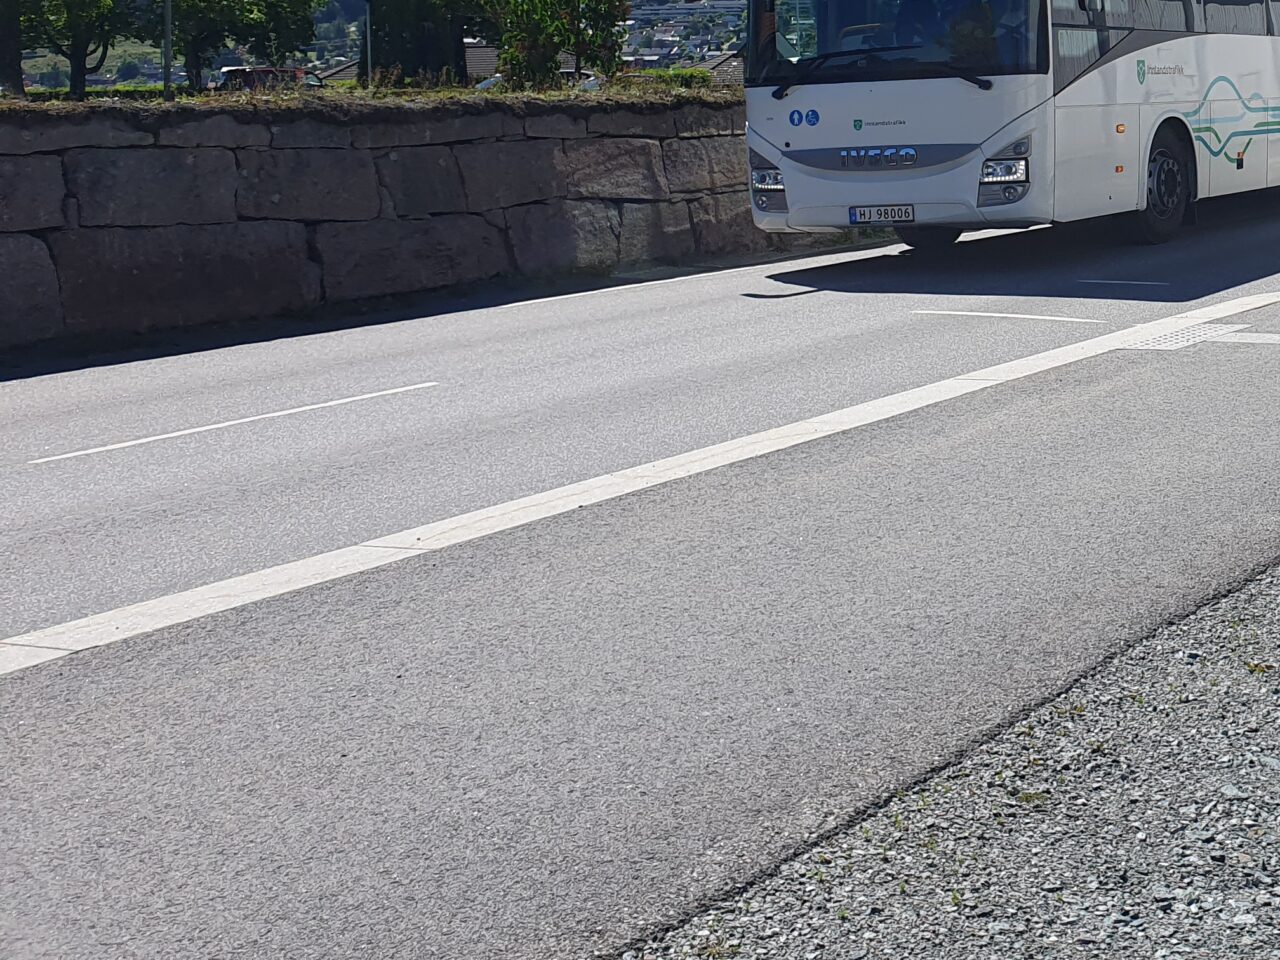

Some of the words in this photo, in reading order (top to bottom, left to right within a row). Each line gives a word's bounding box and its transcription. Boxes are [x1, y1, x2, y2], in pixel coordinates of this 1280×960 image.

[840, 146, 918, 167] IVECO
[859, 209, 872, 220] HJ
[876, 207, 911, 220] 98006
